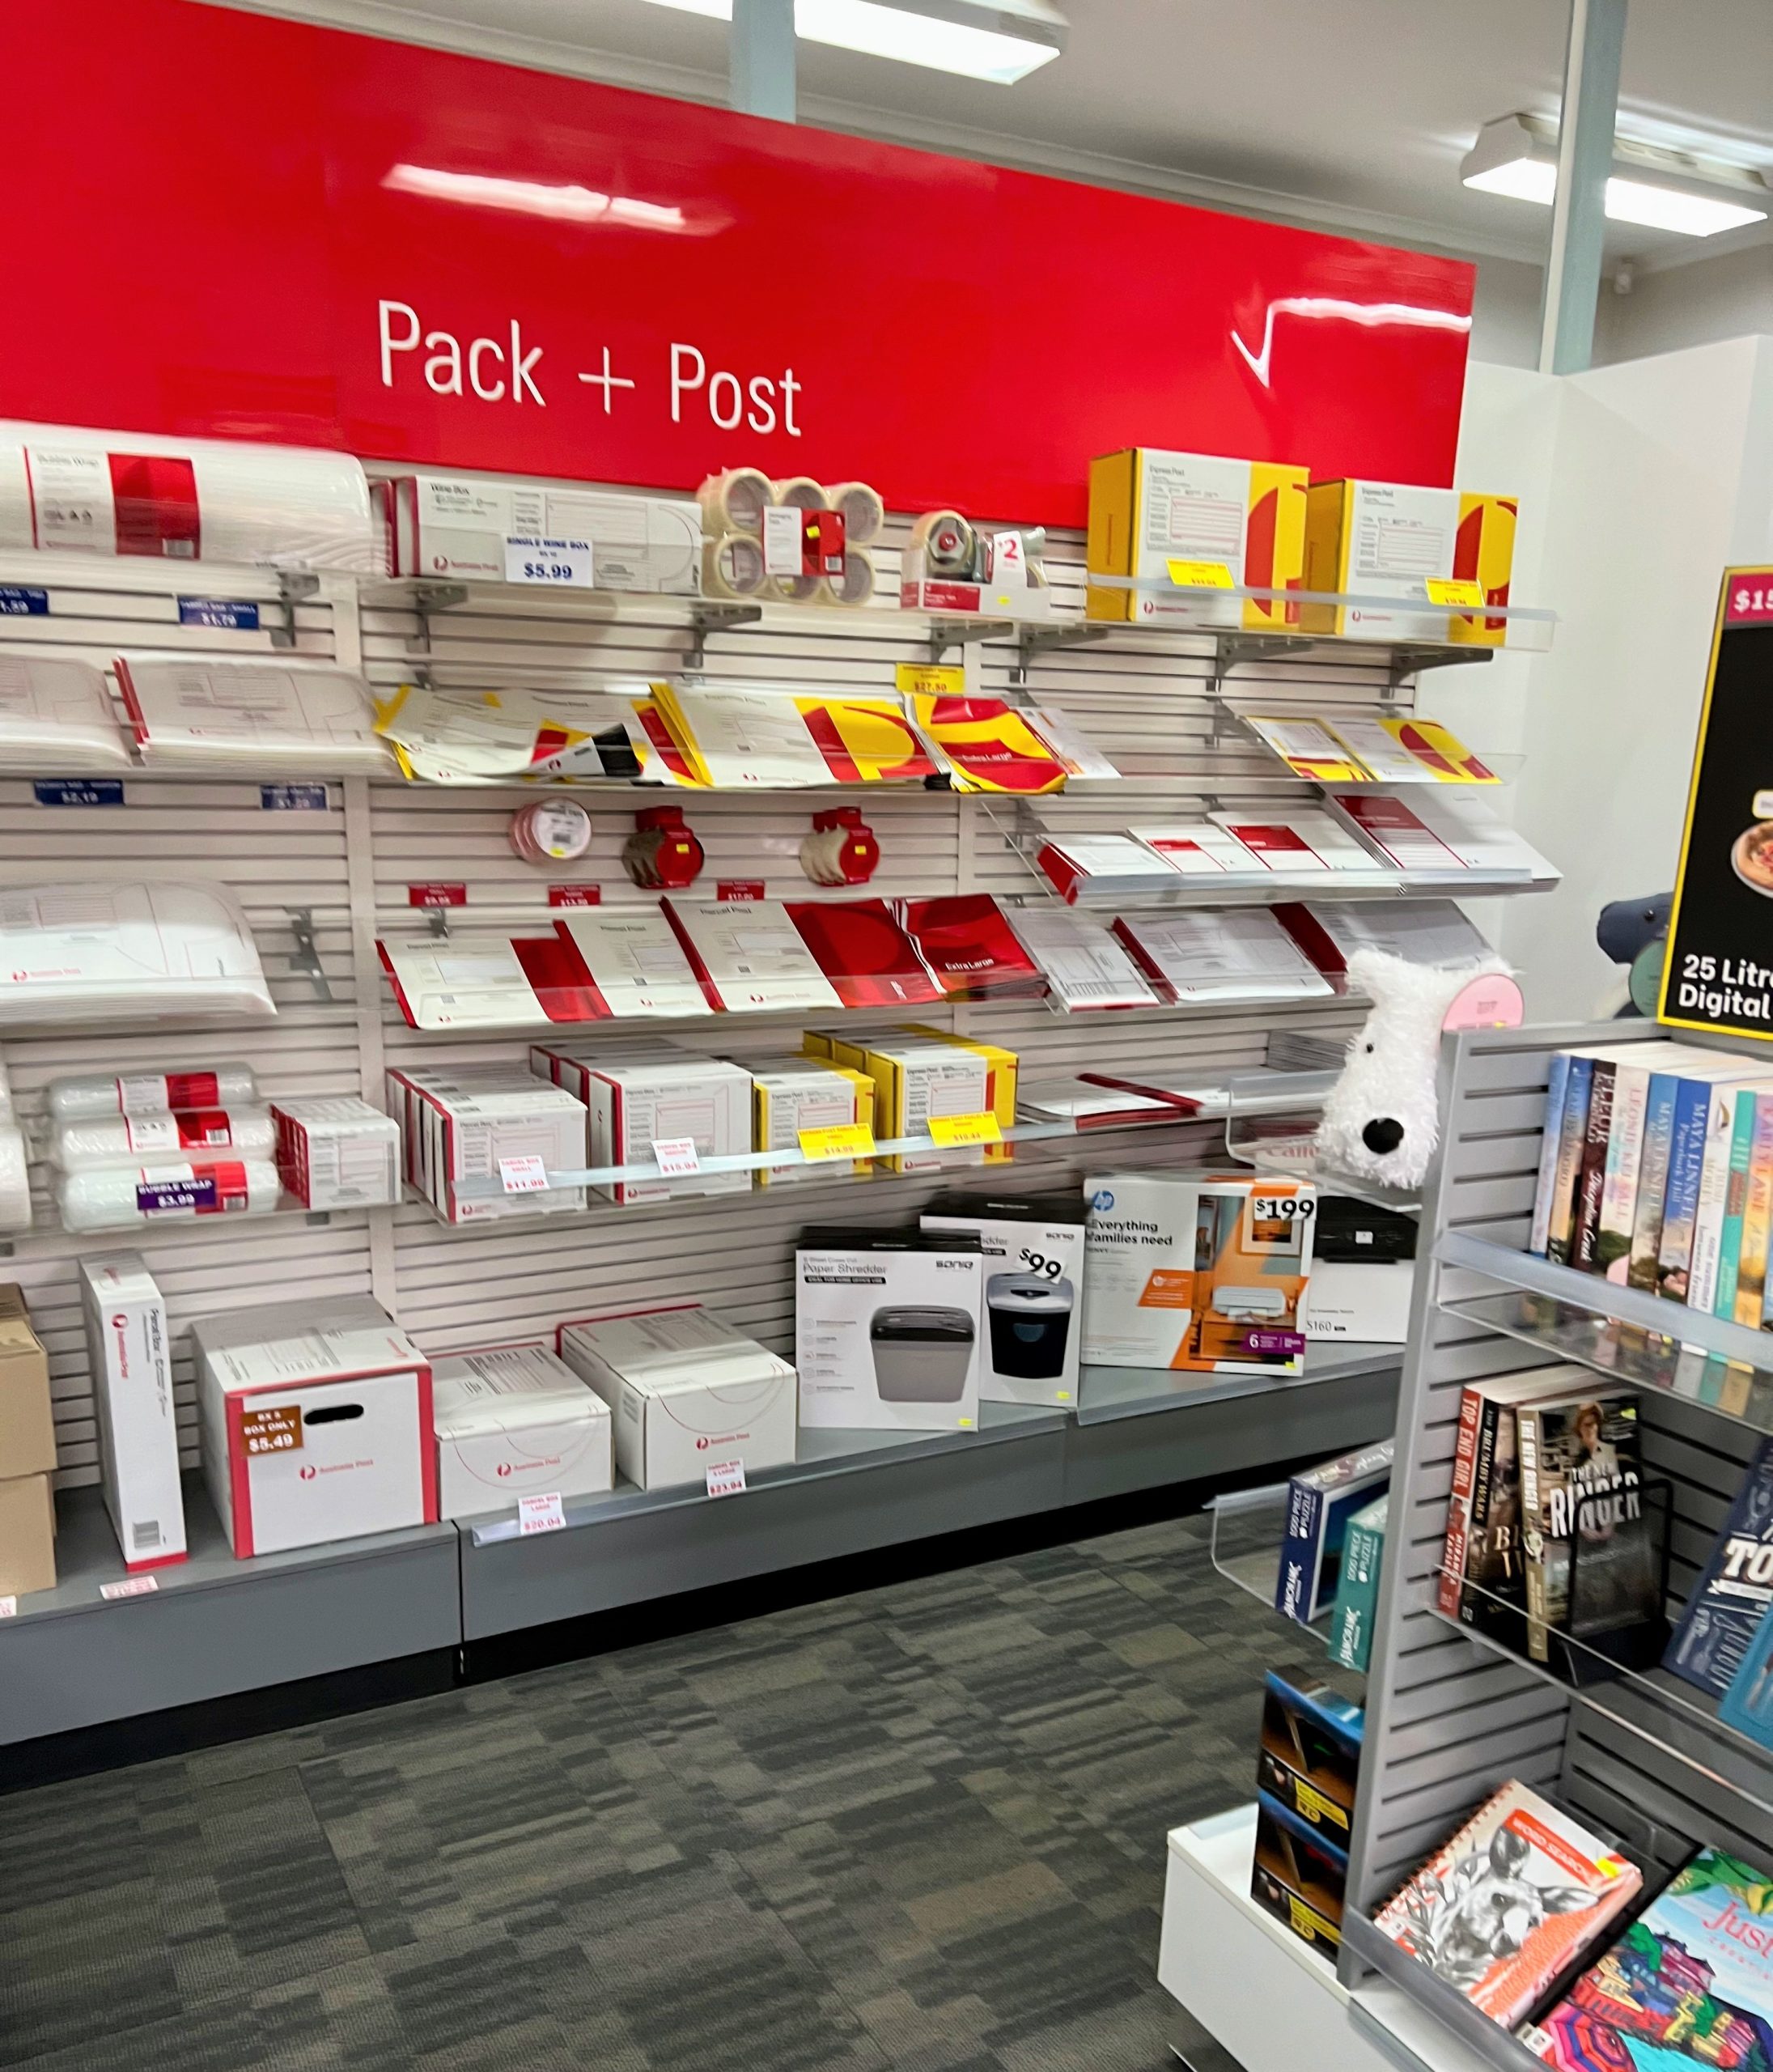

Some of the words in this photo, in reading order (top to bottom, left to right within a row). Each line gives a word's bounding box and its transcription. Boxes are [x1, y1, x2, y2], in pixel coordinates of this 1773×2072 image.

[378, 299, 546, 407] Pack
[577, 346, 635, 415] +
[669, 342, 803, 438] Post
[524, 562, 573, 580] $5.99
[1682, 953, 1716, 982] 25
[1678, 983, 1771, 1020] Digital
[1595, 1072, 1616, 1144] FLEUR
[1656, 1102, 1672, 1141] MAYA
[1689, 1102, 1707, 1148] MAYA
[138, 1182, 180, 1195] BUBBLE
[182, 1179, 212, 1191] WRAP
[158, 1193, 195, 1208] $3.99
[1678, 1152, 1700, 1224] LINNELL
[1255, 1198, 1315, 1221] $199
[1091, 1218, 1159, 1233] Everything
[1141, 1235, 1173, 1246] need
[803, 1263, 834, 1276] Paper
[838, 1263, 887, 1275] Shredder
[1019, 1247, 1062, 1280] $99
[1249, 1333, 1260, 1349] 6
[1461, 1397, 1478, 1424] TOP
[244, 1424, 266, 1436] BOX
[267, 1419, 296, 1433] ONLY
[1521, 1420, 1535, 1439] THE
[248, 1433, 295, 1453] $5.49
[1457, 1429, 1474, 1455] END
[1478, 1429, 1493, 1482] BRUMBY
[1521, 1441, 1536, 1469] NEW
[1453, 1459, 1471, 1488] GIRL
[1292, 1488, 1304, 1515] PIECE
[1299, 1491, 1313, 1528] PUZZLE
[1474, 1481, 1488, 1521] WARS
[1350, 1530, 1362, 1559] PIECE
[1359, 1534, 1372, 1572] PUZZLE
[1512, 1816, 1547, 1846] WORD
